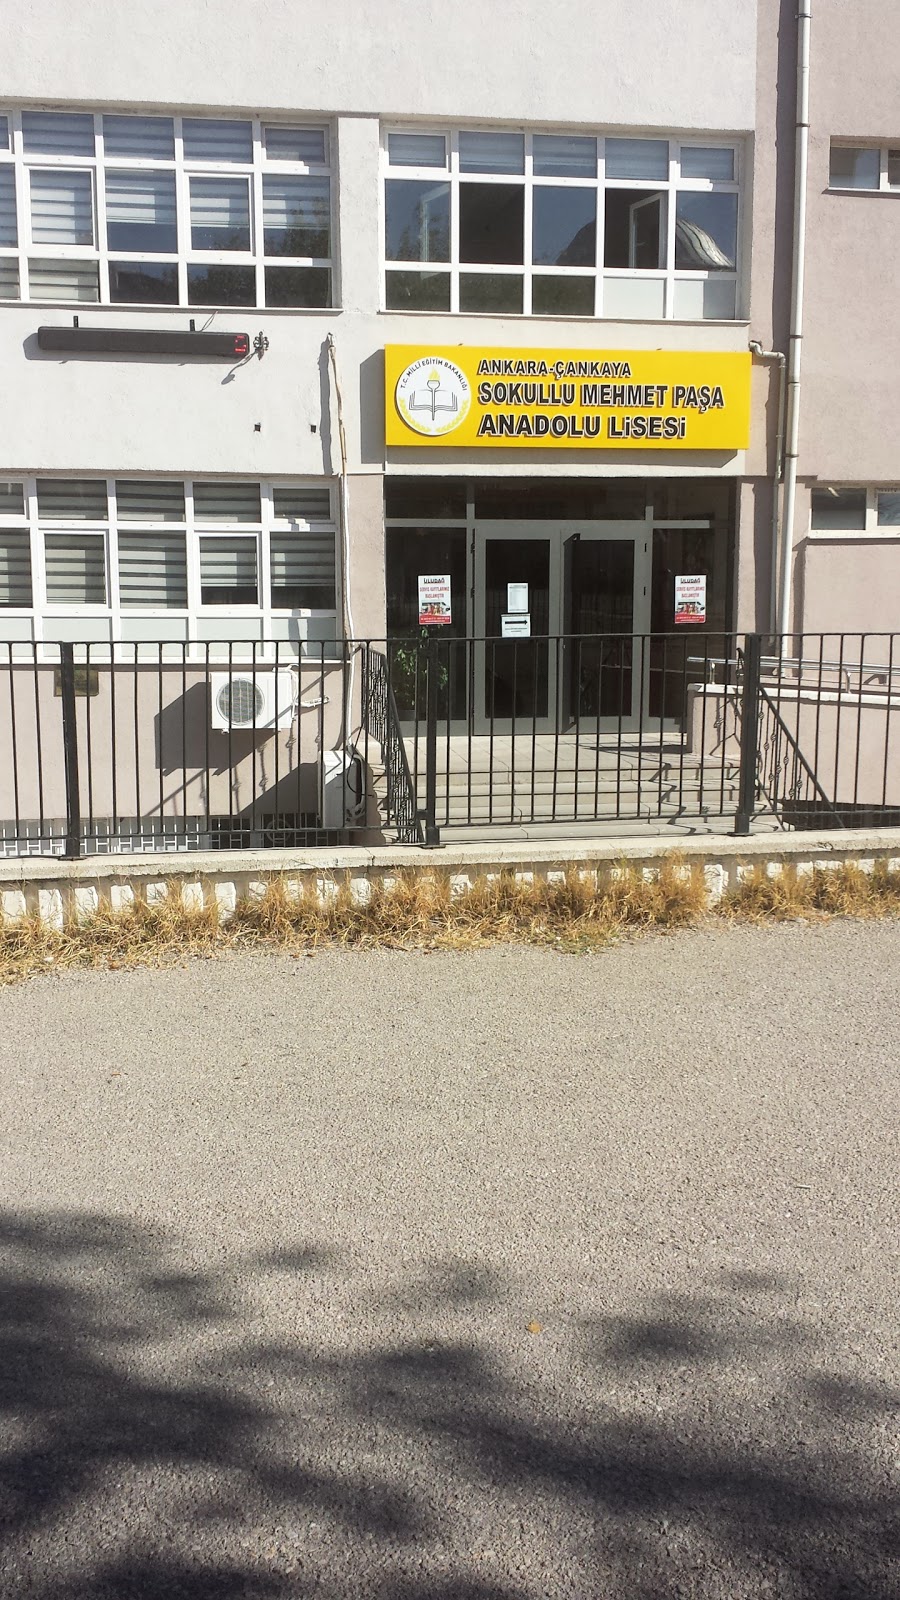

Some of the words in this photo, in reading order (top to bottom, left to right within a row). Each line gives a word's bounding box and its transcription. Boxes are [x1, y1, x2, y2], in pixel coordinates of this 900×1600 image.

[422, 358, 443, 367] EĞİTİM
[444, 362, 468, 391] BAKANLIĞI
[478, 359, 632, 379] ANKARA-ÇANKAYA
[479, 381, 576, 405] SOKULLU
[581, 384, 668, 408] MEHMET
[672, 385, 725, 413] PAŞA
[477, 413, 601, 438] ANADOLU
